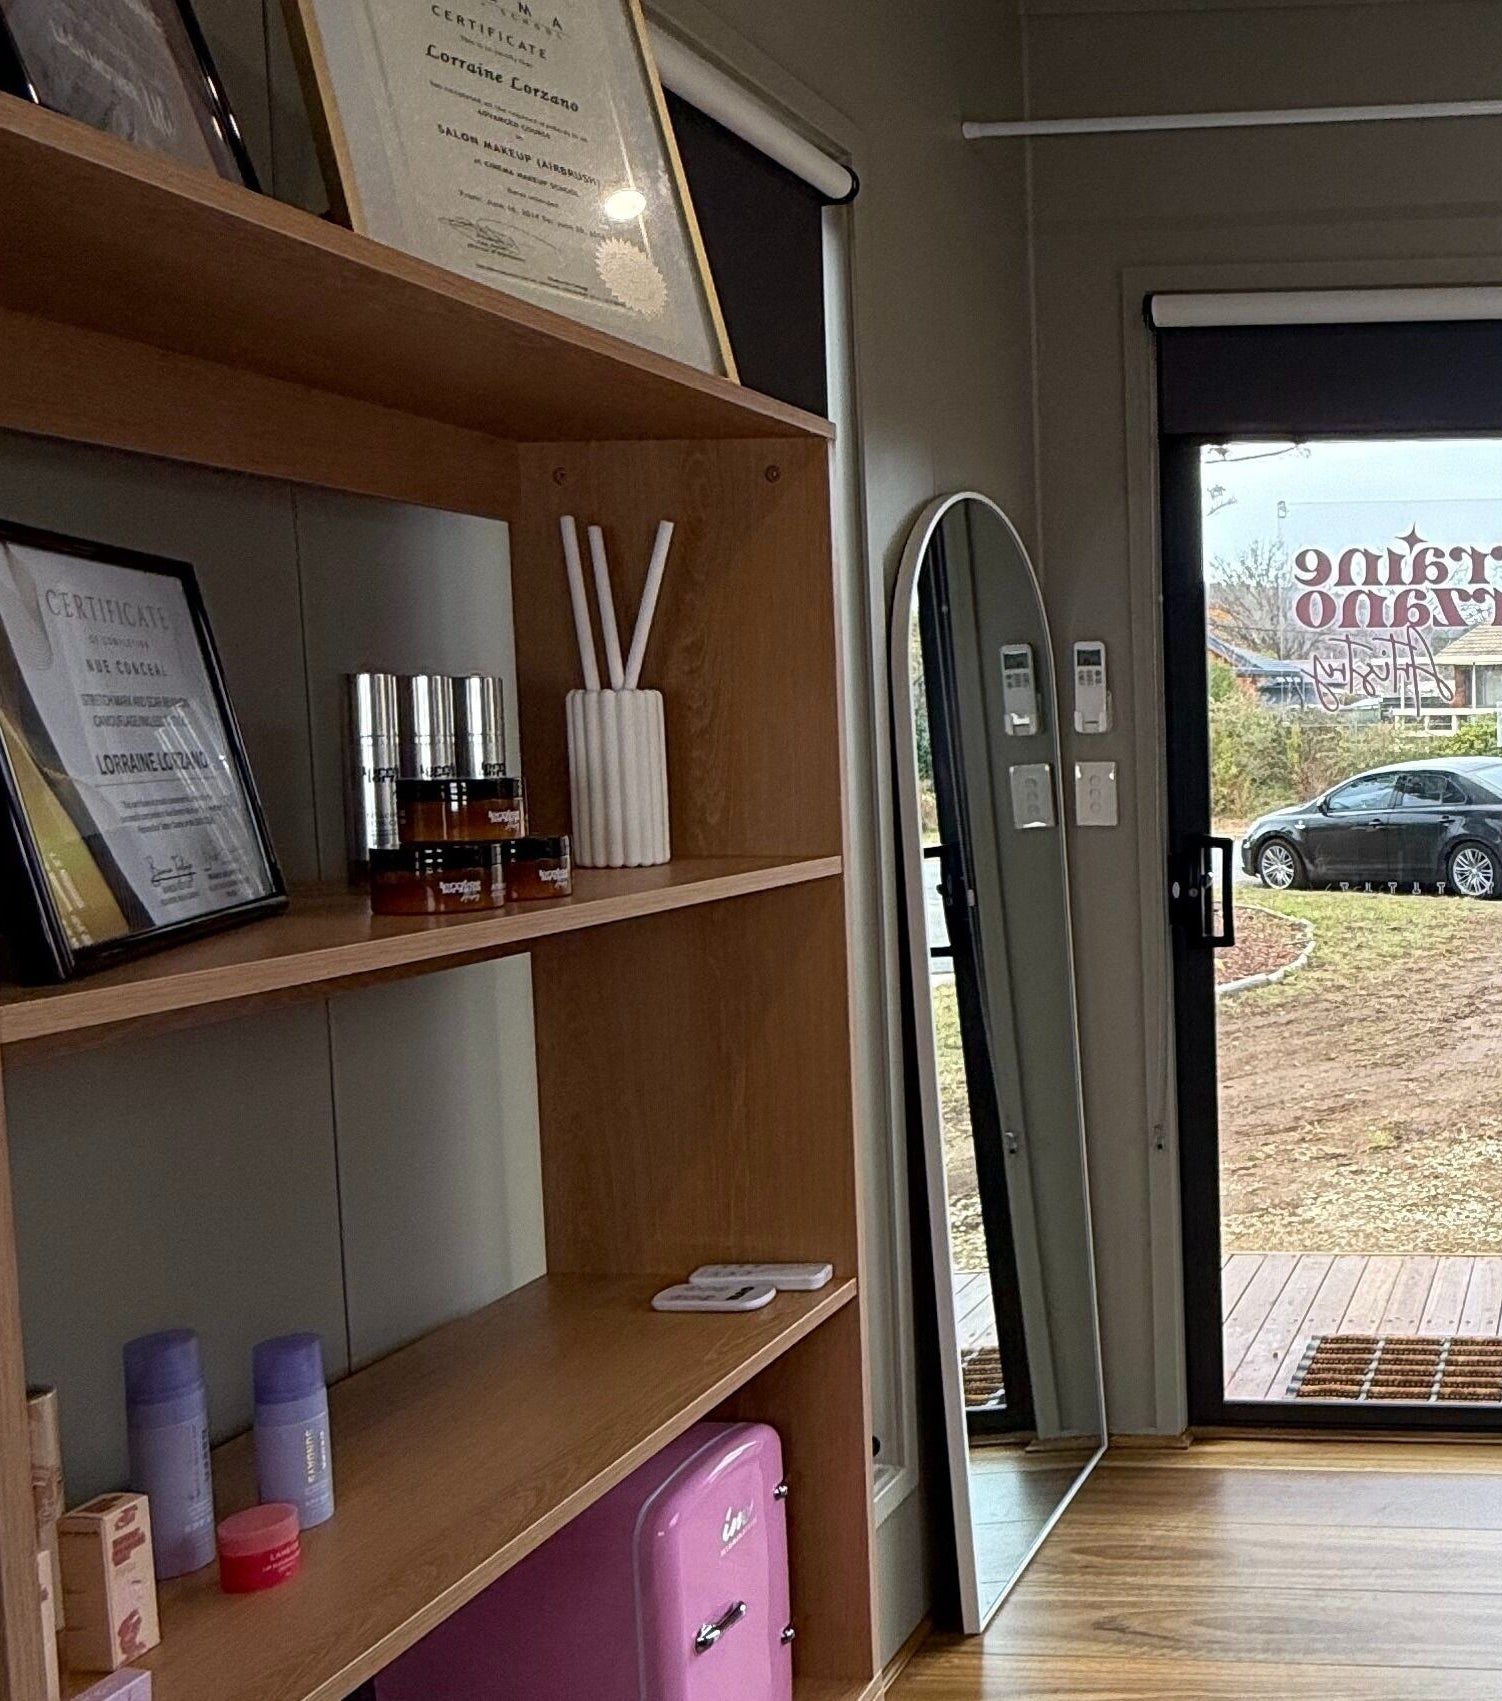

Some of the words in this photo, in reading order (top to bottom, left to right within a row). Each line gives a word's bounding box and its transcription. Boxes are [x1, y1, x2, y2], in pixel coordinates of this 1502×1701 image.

[431, 4, 547, 60] CERTIFICATE
[425, 43, 504, 83] Lorraine
[509, 76, 579, 113] Lorzano
[437, 123, 479, 146] SALON
[483, 139, 533, 163] MAKEUP
[45, 589, 169, 630] CERTIFICATE
[115, 660, 169, 677] CONCEAL
[96, 752, 158, 775] LORRAINE
